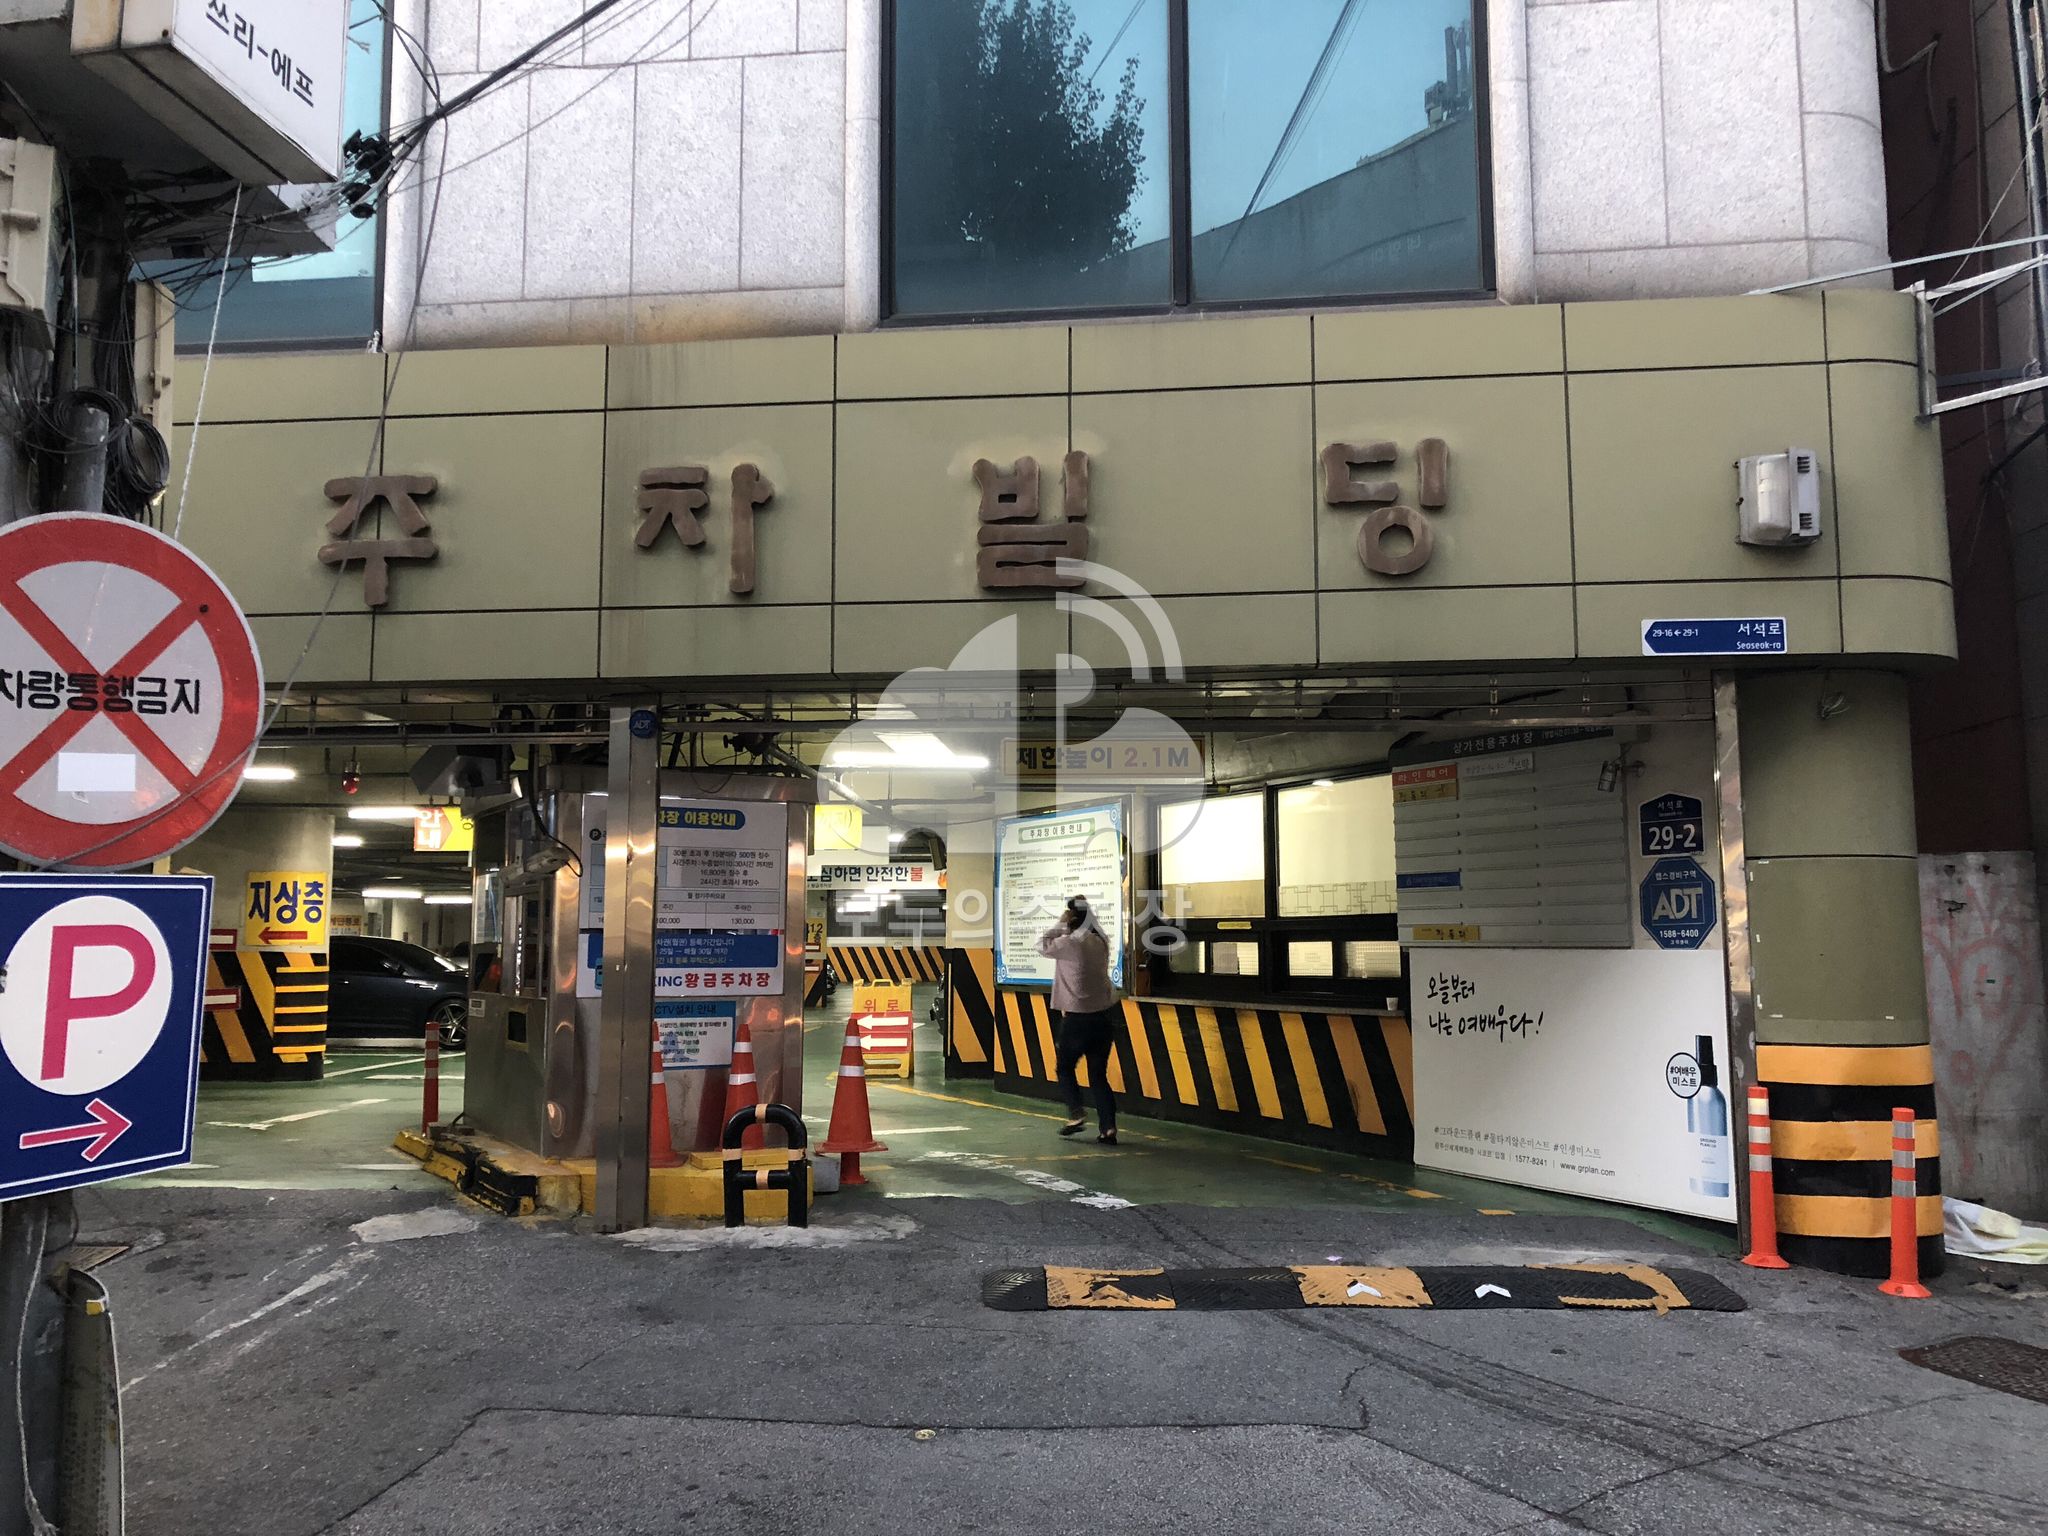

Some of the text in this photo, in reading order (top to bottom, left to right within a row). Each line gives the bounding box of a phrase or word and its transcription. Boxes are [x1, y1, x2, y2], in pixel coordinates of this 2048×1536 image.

[1652, 628, 1699, 638] 29-16 29-1
[1737, 622, 1782, 637] 서석로
[1736, 641, 1781, 650] Seoseok-ro
[632, 719, 653, 730] ADT
[1016, 746, 1190, 770] 제한높이 2.1M
[1657, 800, 1684, 811] 서석로
[684, 810, 737, 827] 이용안내
[1648, 823, 1697, 851] 29-2
[248, 880, 325, 924] 지상층
[1651, 886, 1703, 921] ADT
[1659, 929, 1699, 938] 1588-6400
[684, 972, 770, 988] 황금주차장
[1427, 972, 1475, 1005] 오늘부터
[41, 924, 156, 1081] P
[1428, 1004, 1544, 1043] 나는 여배우다!
[1669, 1066, 1697, 1077] #여배우
[1672, 1078, 1698, 1087] 미스트
[1553, 1143, 1602, 1159] #인생미스트
[1514, 1153, 1548, 1167] 1577-8241
[1559, 1160, 1616, 1177] www.grplan.com
